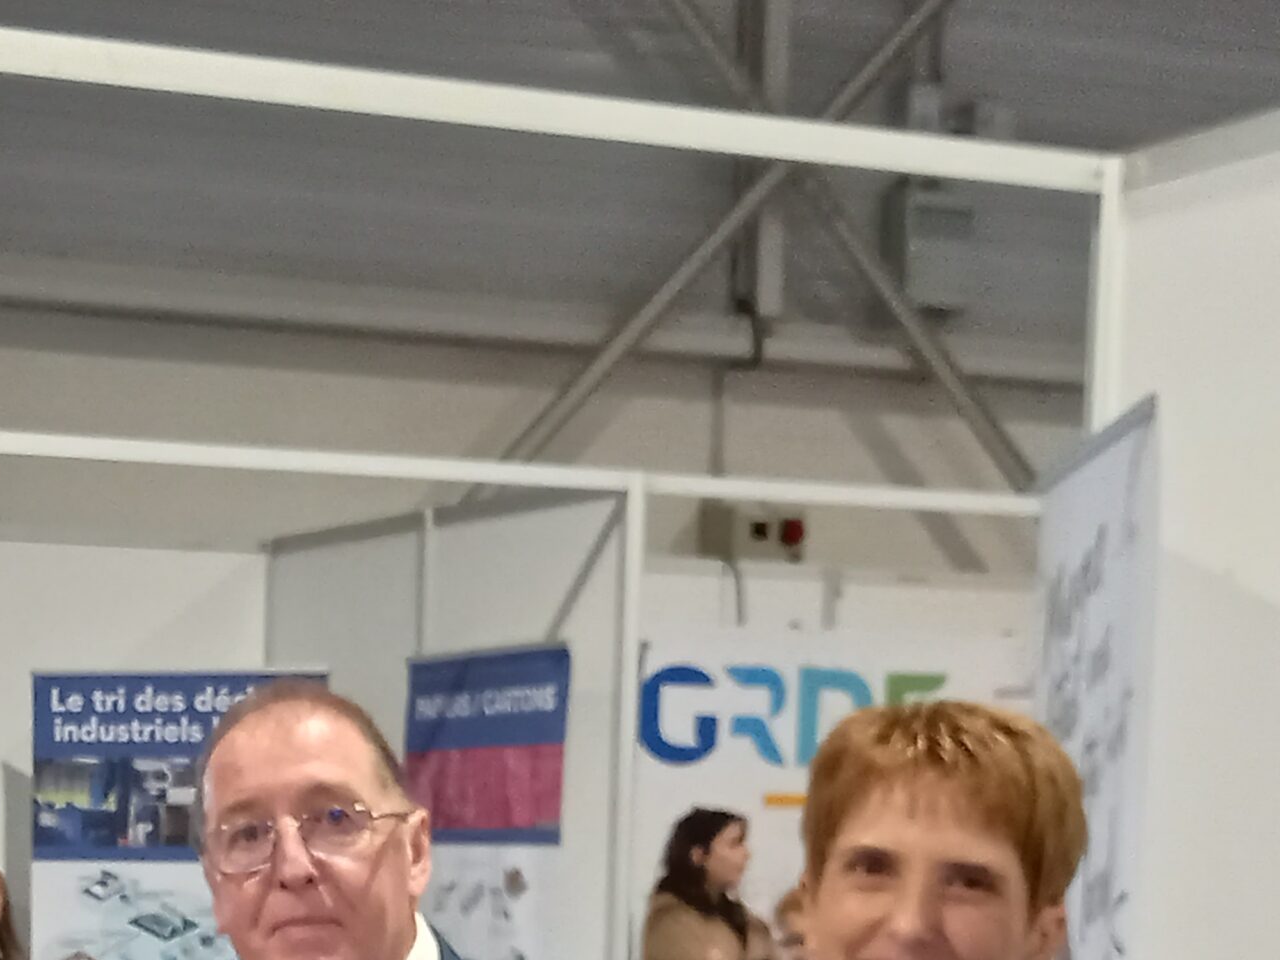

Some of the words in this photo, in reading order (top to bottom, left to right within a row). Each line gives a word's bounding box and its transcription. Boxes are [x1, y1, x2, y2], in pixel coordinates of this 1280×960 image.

[50, 687, 84, 713] Le
[91, 687, 126, 713] tri
[133, 686, 187, 713] des
[53, 716, 205, 743] industriels
